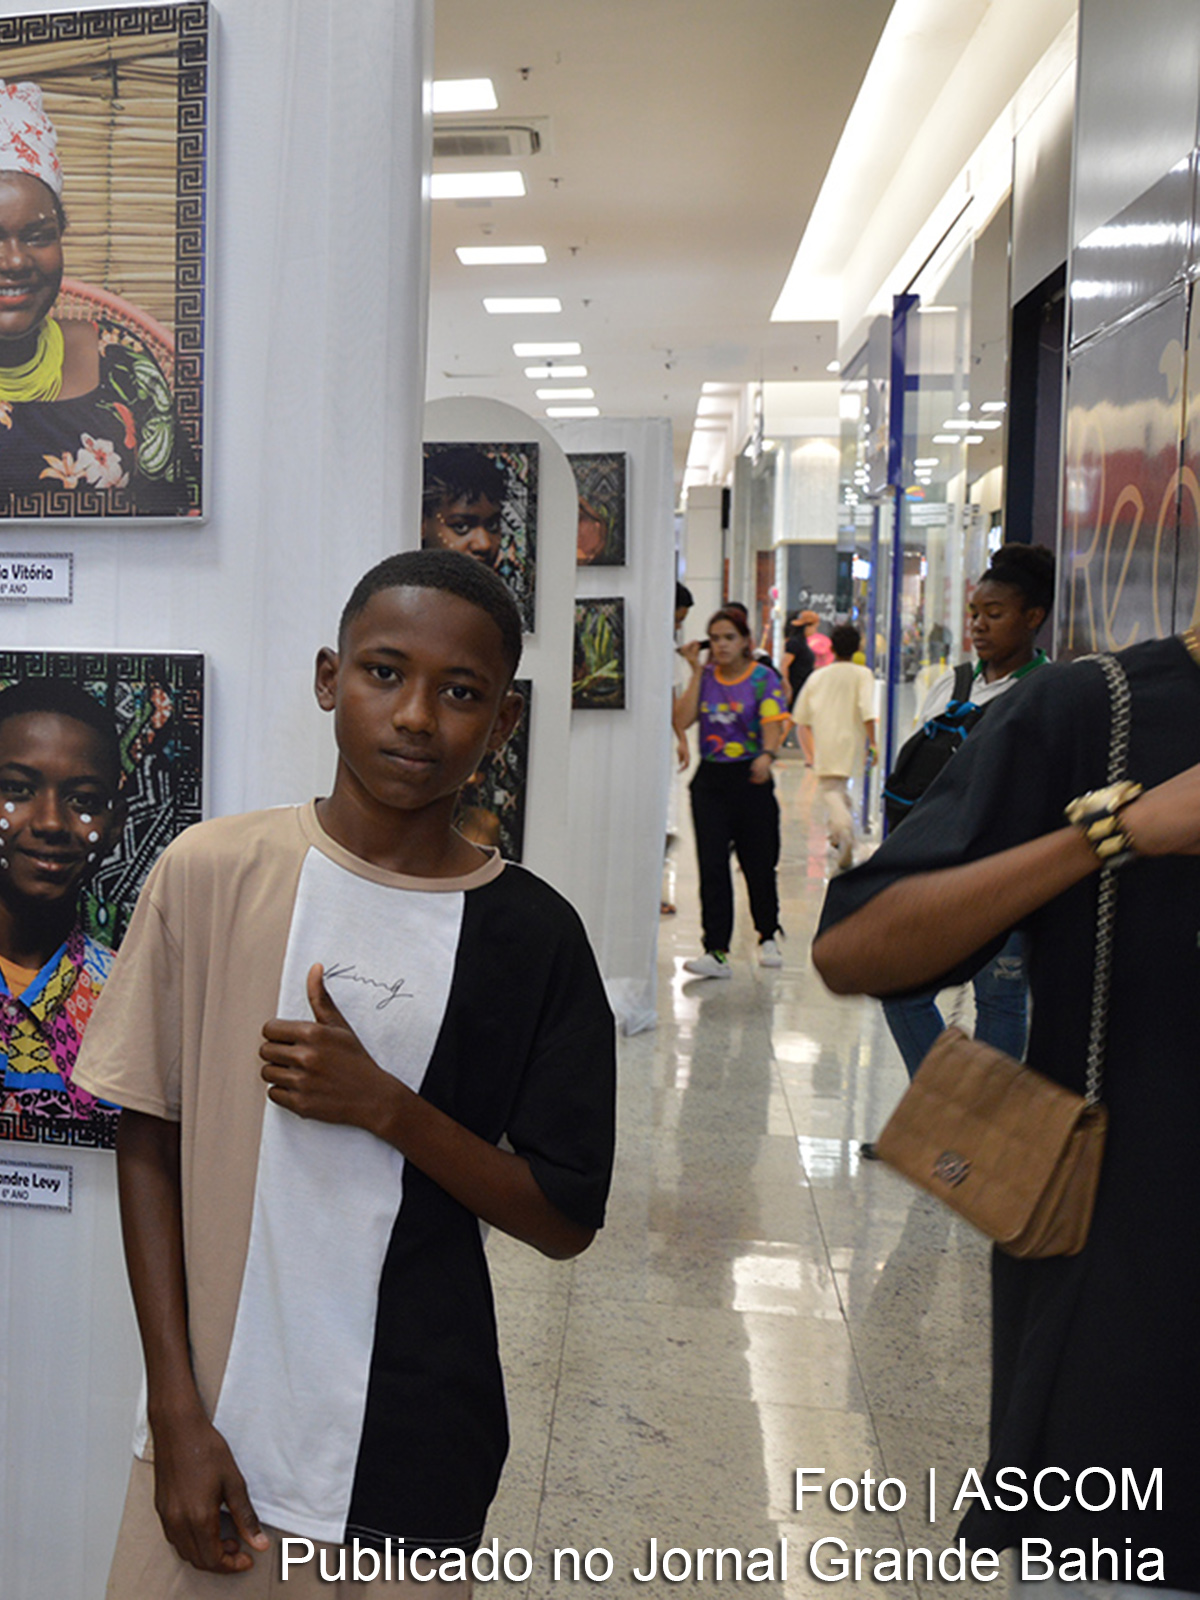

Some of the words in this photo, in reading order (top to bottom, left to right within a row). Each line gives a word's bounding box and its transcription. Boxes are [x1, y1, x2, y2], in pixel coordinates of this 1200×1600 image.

[11, 564, 53, 580] Vitória
[9, 583, 28, 594] ANO
[32, 1173, 60, 1193] Levy
[10, 1189, 29, 1200] ANO
